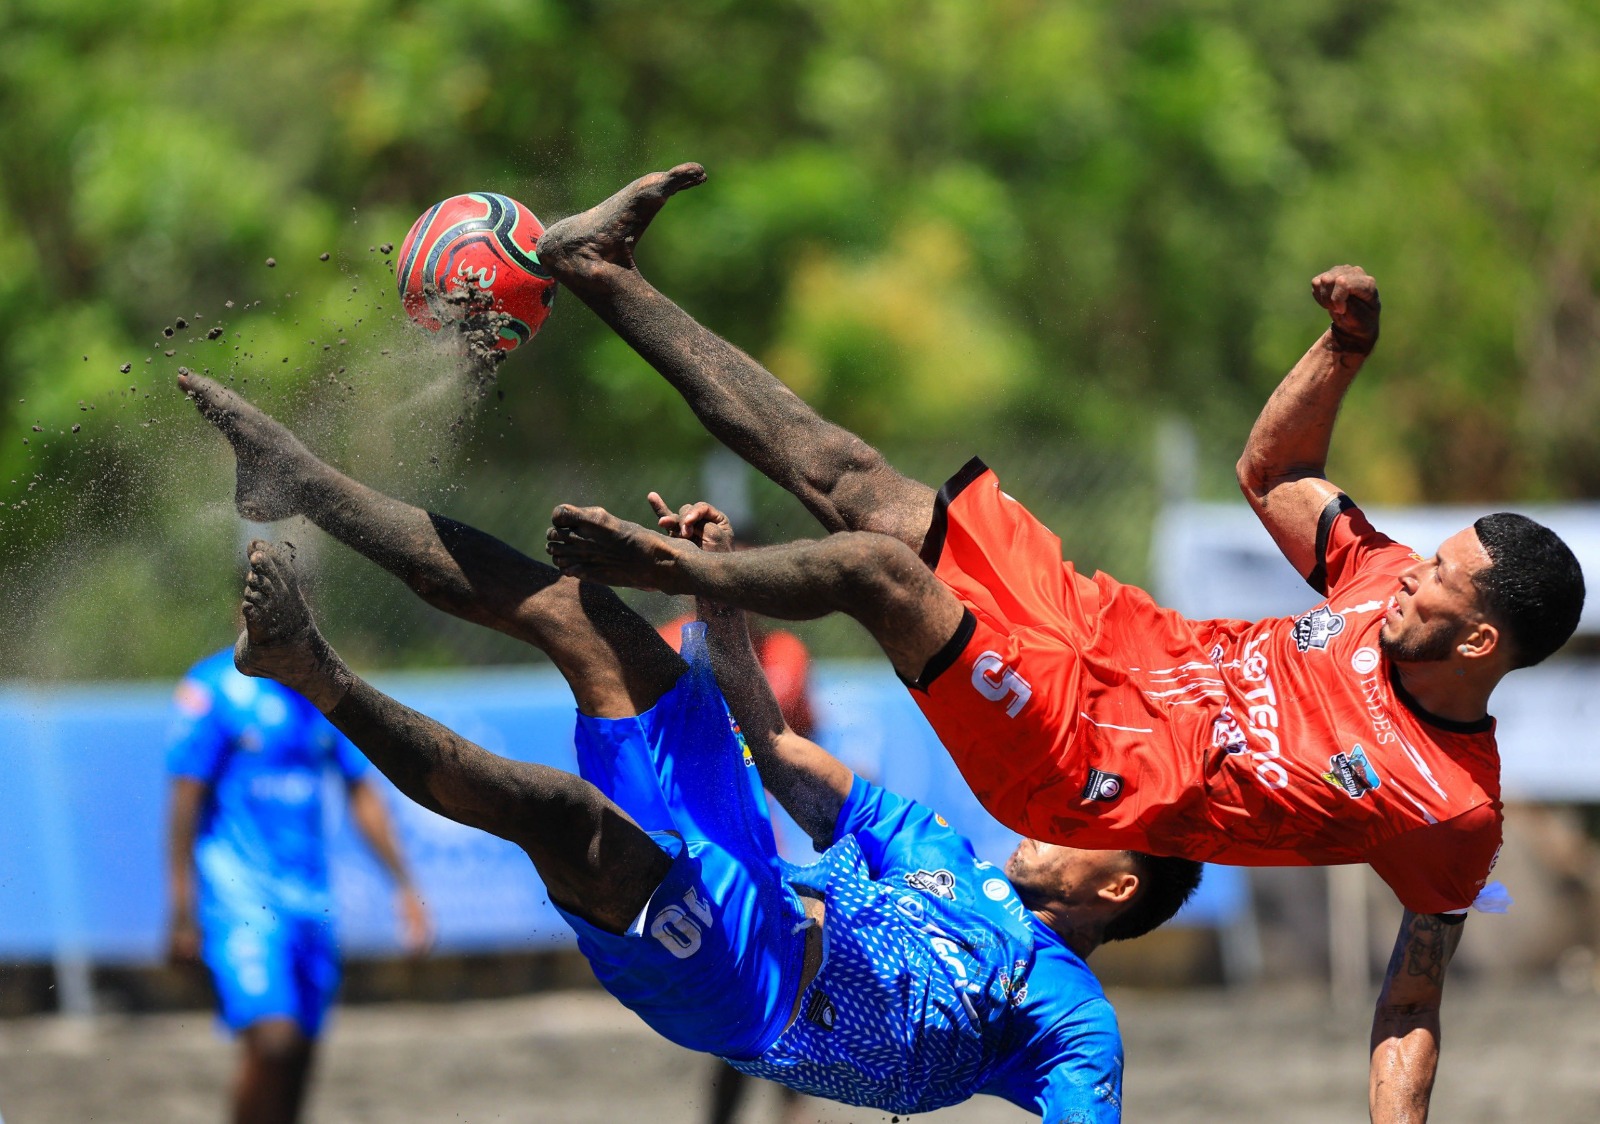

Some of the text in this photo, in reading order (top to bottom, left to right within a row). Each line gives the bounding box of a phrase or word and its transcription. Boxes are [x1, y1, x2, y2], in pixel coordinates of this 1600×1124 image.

[971, 650, 1033, 719] 5
[1360, 675, 1396, 745] INDES
[650, 884, 714, 959] 10
